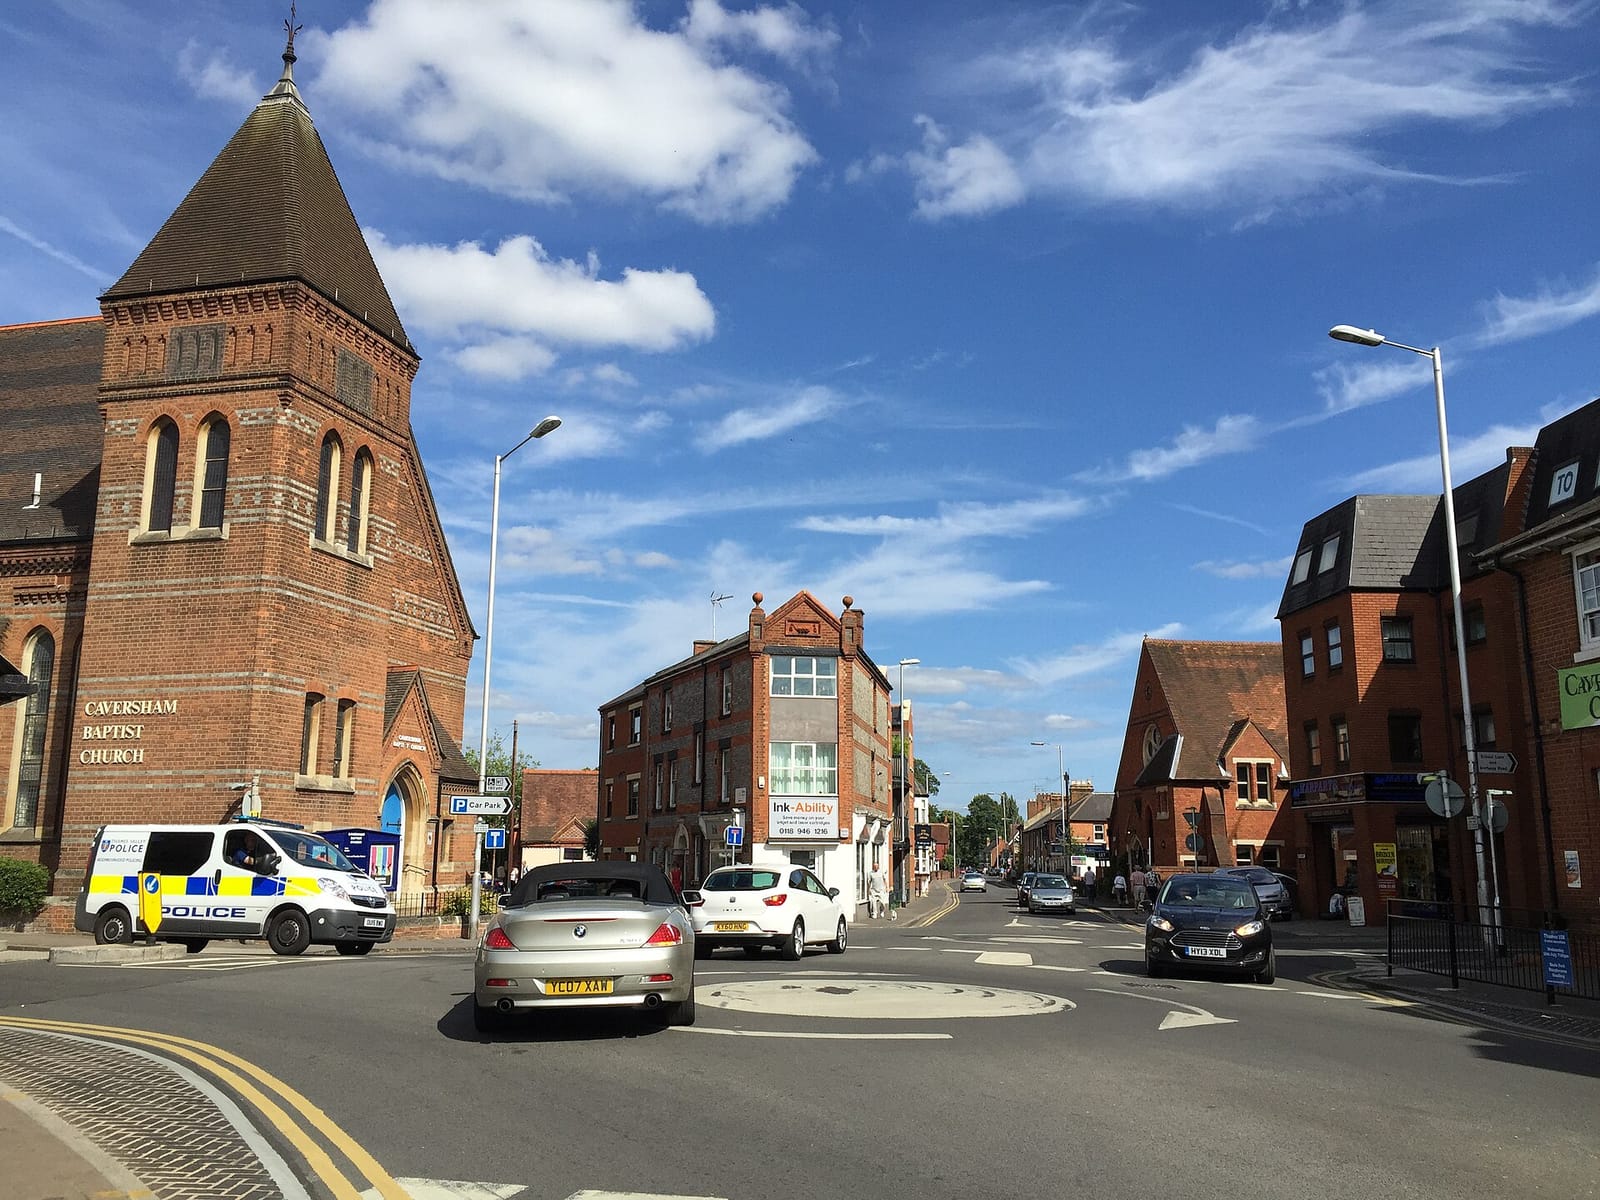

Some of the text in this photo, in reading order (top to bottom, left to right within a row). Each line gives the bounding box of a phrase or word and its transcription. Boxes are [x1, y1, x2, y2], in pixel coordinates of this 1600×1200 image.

[1557, 470, 1574, 496] TO
[84, 699, 178, 716] CAVERSHAM
[82, 724, 145, 740] BAPTIST
[79, 748, 145, 764] CHURCH
[469, 801, 501, 809] Car Park
[773, 801, 833, 816] Ink-Ability
[779, 827, 794, 835] 0118
[797, 827, 811, 835] 946
[109, 844, 144, 853] POLICE
[161, 906, 247, 918] POLICE
[1190, 947, 1208, 956] HY13
[551, 979, 608, 993] YC07 XAW
